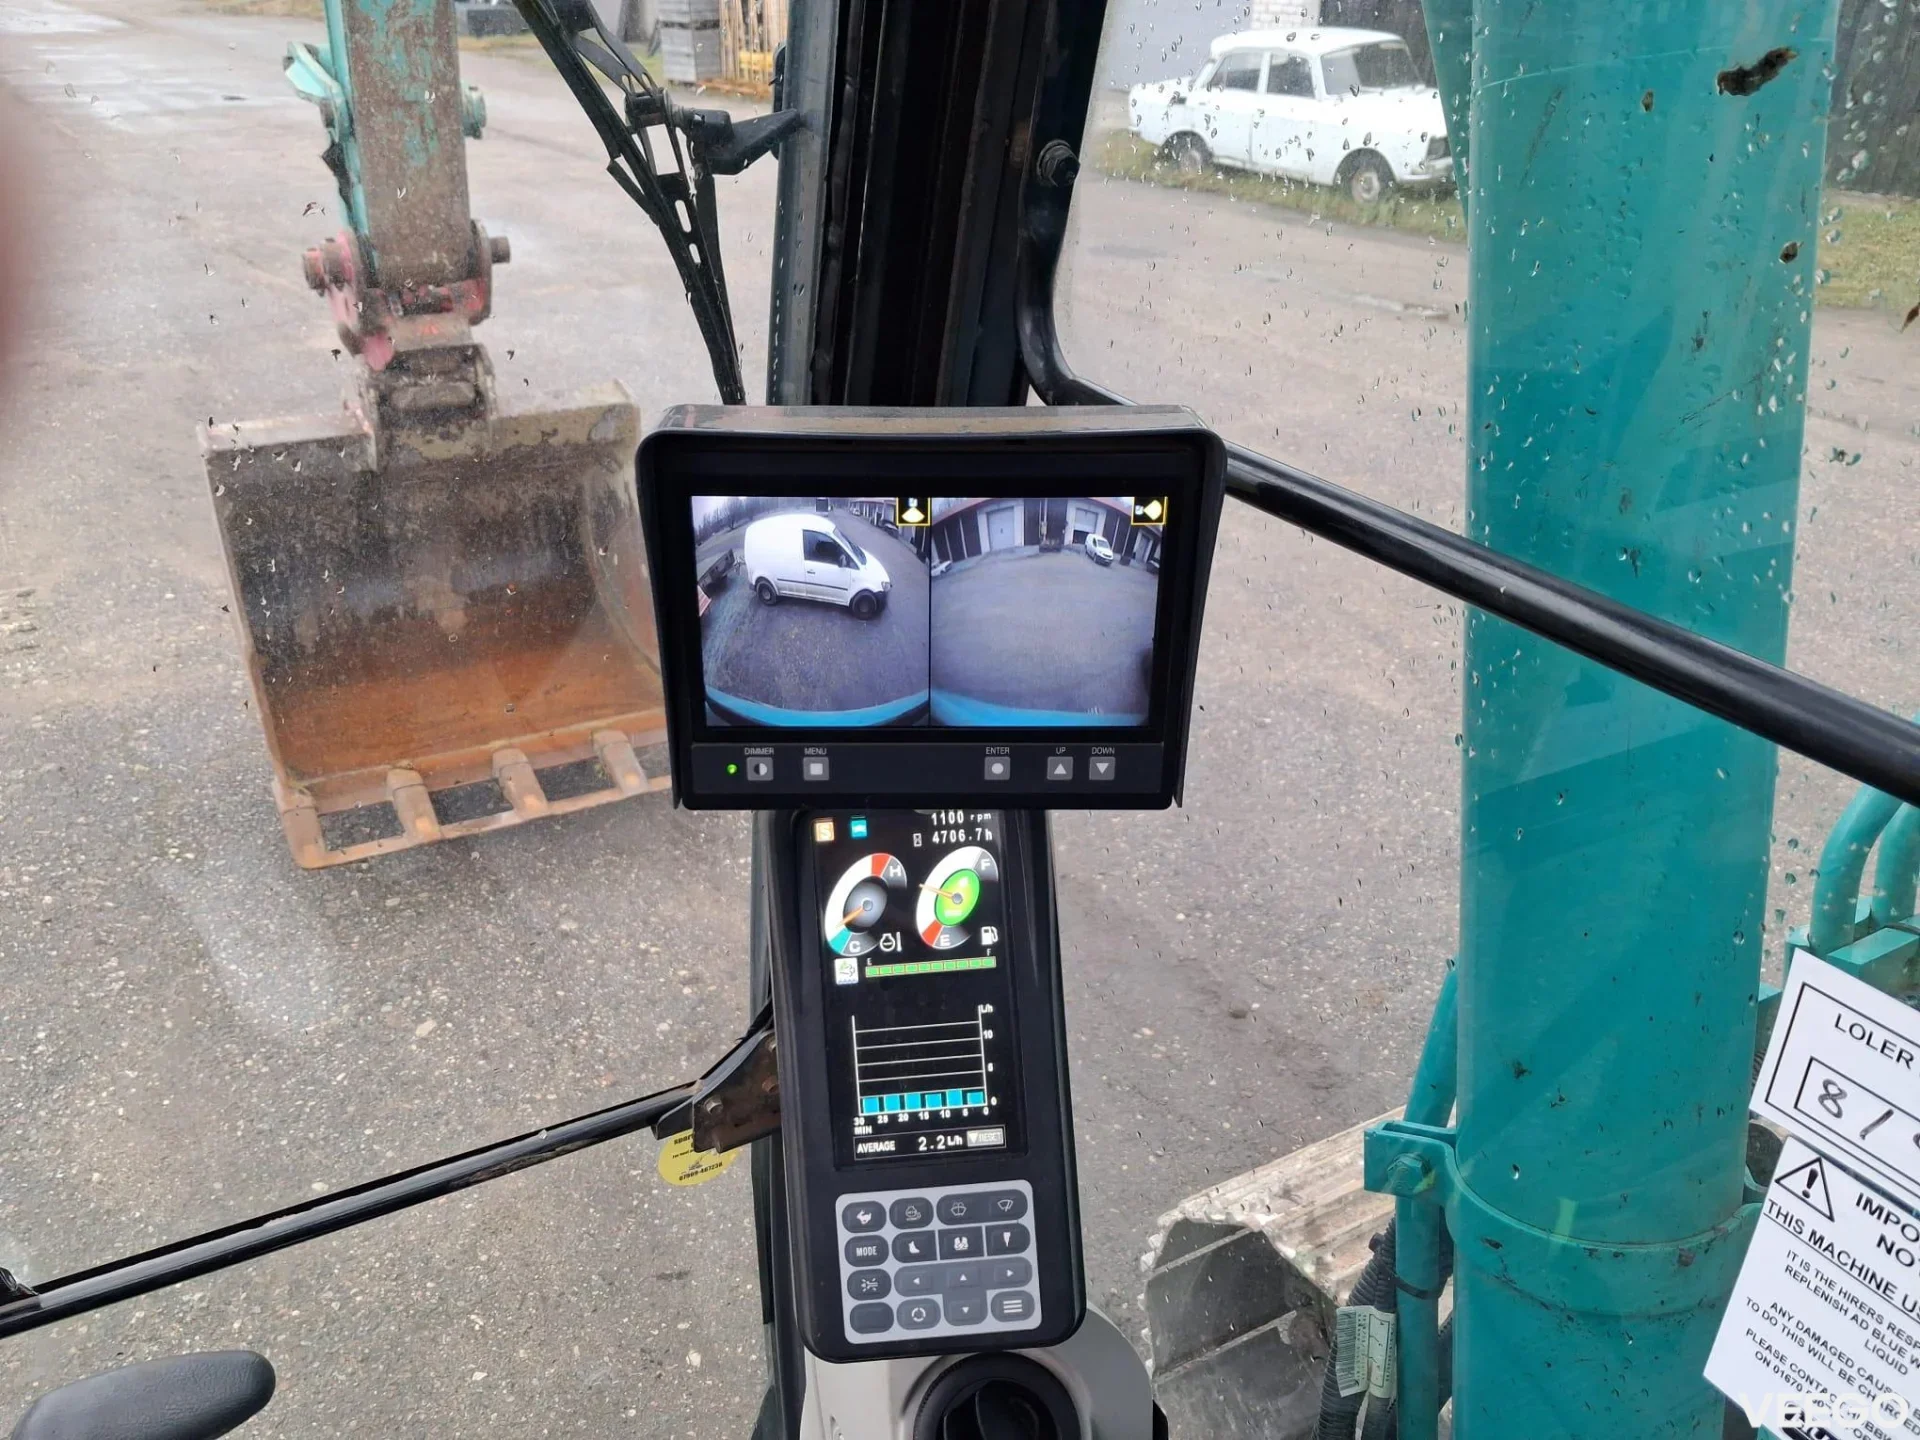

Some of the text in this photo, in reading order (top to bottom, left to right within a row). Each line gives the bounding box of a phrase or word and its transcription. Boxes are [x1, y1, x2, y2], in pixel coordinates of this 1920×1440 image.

[744, 747, 774, 755] DIMMER
[804, 747, 827, 755] MENU
[985, 746, 1010, 755] ENTER
[1055, 746, 1066, 755] UP
[1091, 746, 1115, 755] DOWN
[931, 809, 991, 826] 1100 rpm
[889, 865, 901, 877] H
[980, 858, 991, 870] F
[849, 941, 861, 953] C
[939, 934, 951, 947] E
[983, 1028, 993, 1040] 10
[1834, 1013, 1915, 1070] LOLER
[853, 1117, 865, 1126] 30
[898, 1113, 909, 1122] 20
[939, 1110, 951, 1119] 10
[854, 1126, 872, 1135] MIN
[857, 1140, 896, 1154] AVERAGE
[918, 1135, 945, 1151] 2.2
[856, 1245, 877, 1257] MODE
[1767, 1198, 1805, 1235] THIS
[1808, 1228, 1898, 1301] MACHINE
[1876, 1232, 1920, 1268] NO
[1786, 1250, 1799, 1263] IT
[1799, 1259, 1811, 1273] IS
[1814, 1268, 1838, 1291] THE
[1838, 1286, 1885, 1325] HIRERS
[1784, 1264, 1849, 1317] REPLENISH
[1850, 1313, 1869, 1331] AD
[1871, 1327, 1908, 1359] BLUE
[1746, 1296, 1760, 1313] TO
[1761, 1309, 1778, 1327] DO
[1781, 1323, 1806, 1348] THIS
[1807, 1343, 1835, 1373] WILL
[1838, 1368, 1857, 1387] BE
[1770, 1301, 1794, 1323] ANY
[1795, 1320, 1855, 1369] DAMAGED
[1864, 1338, 1909, 1376] LIQUID
[1745, 1327, 1788, 1365] PLEASE
[1789, 1362, 1840, 1405] CONTAC
[1754, 1350, 1803, 1393] ON 01670
